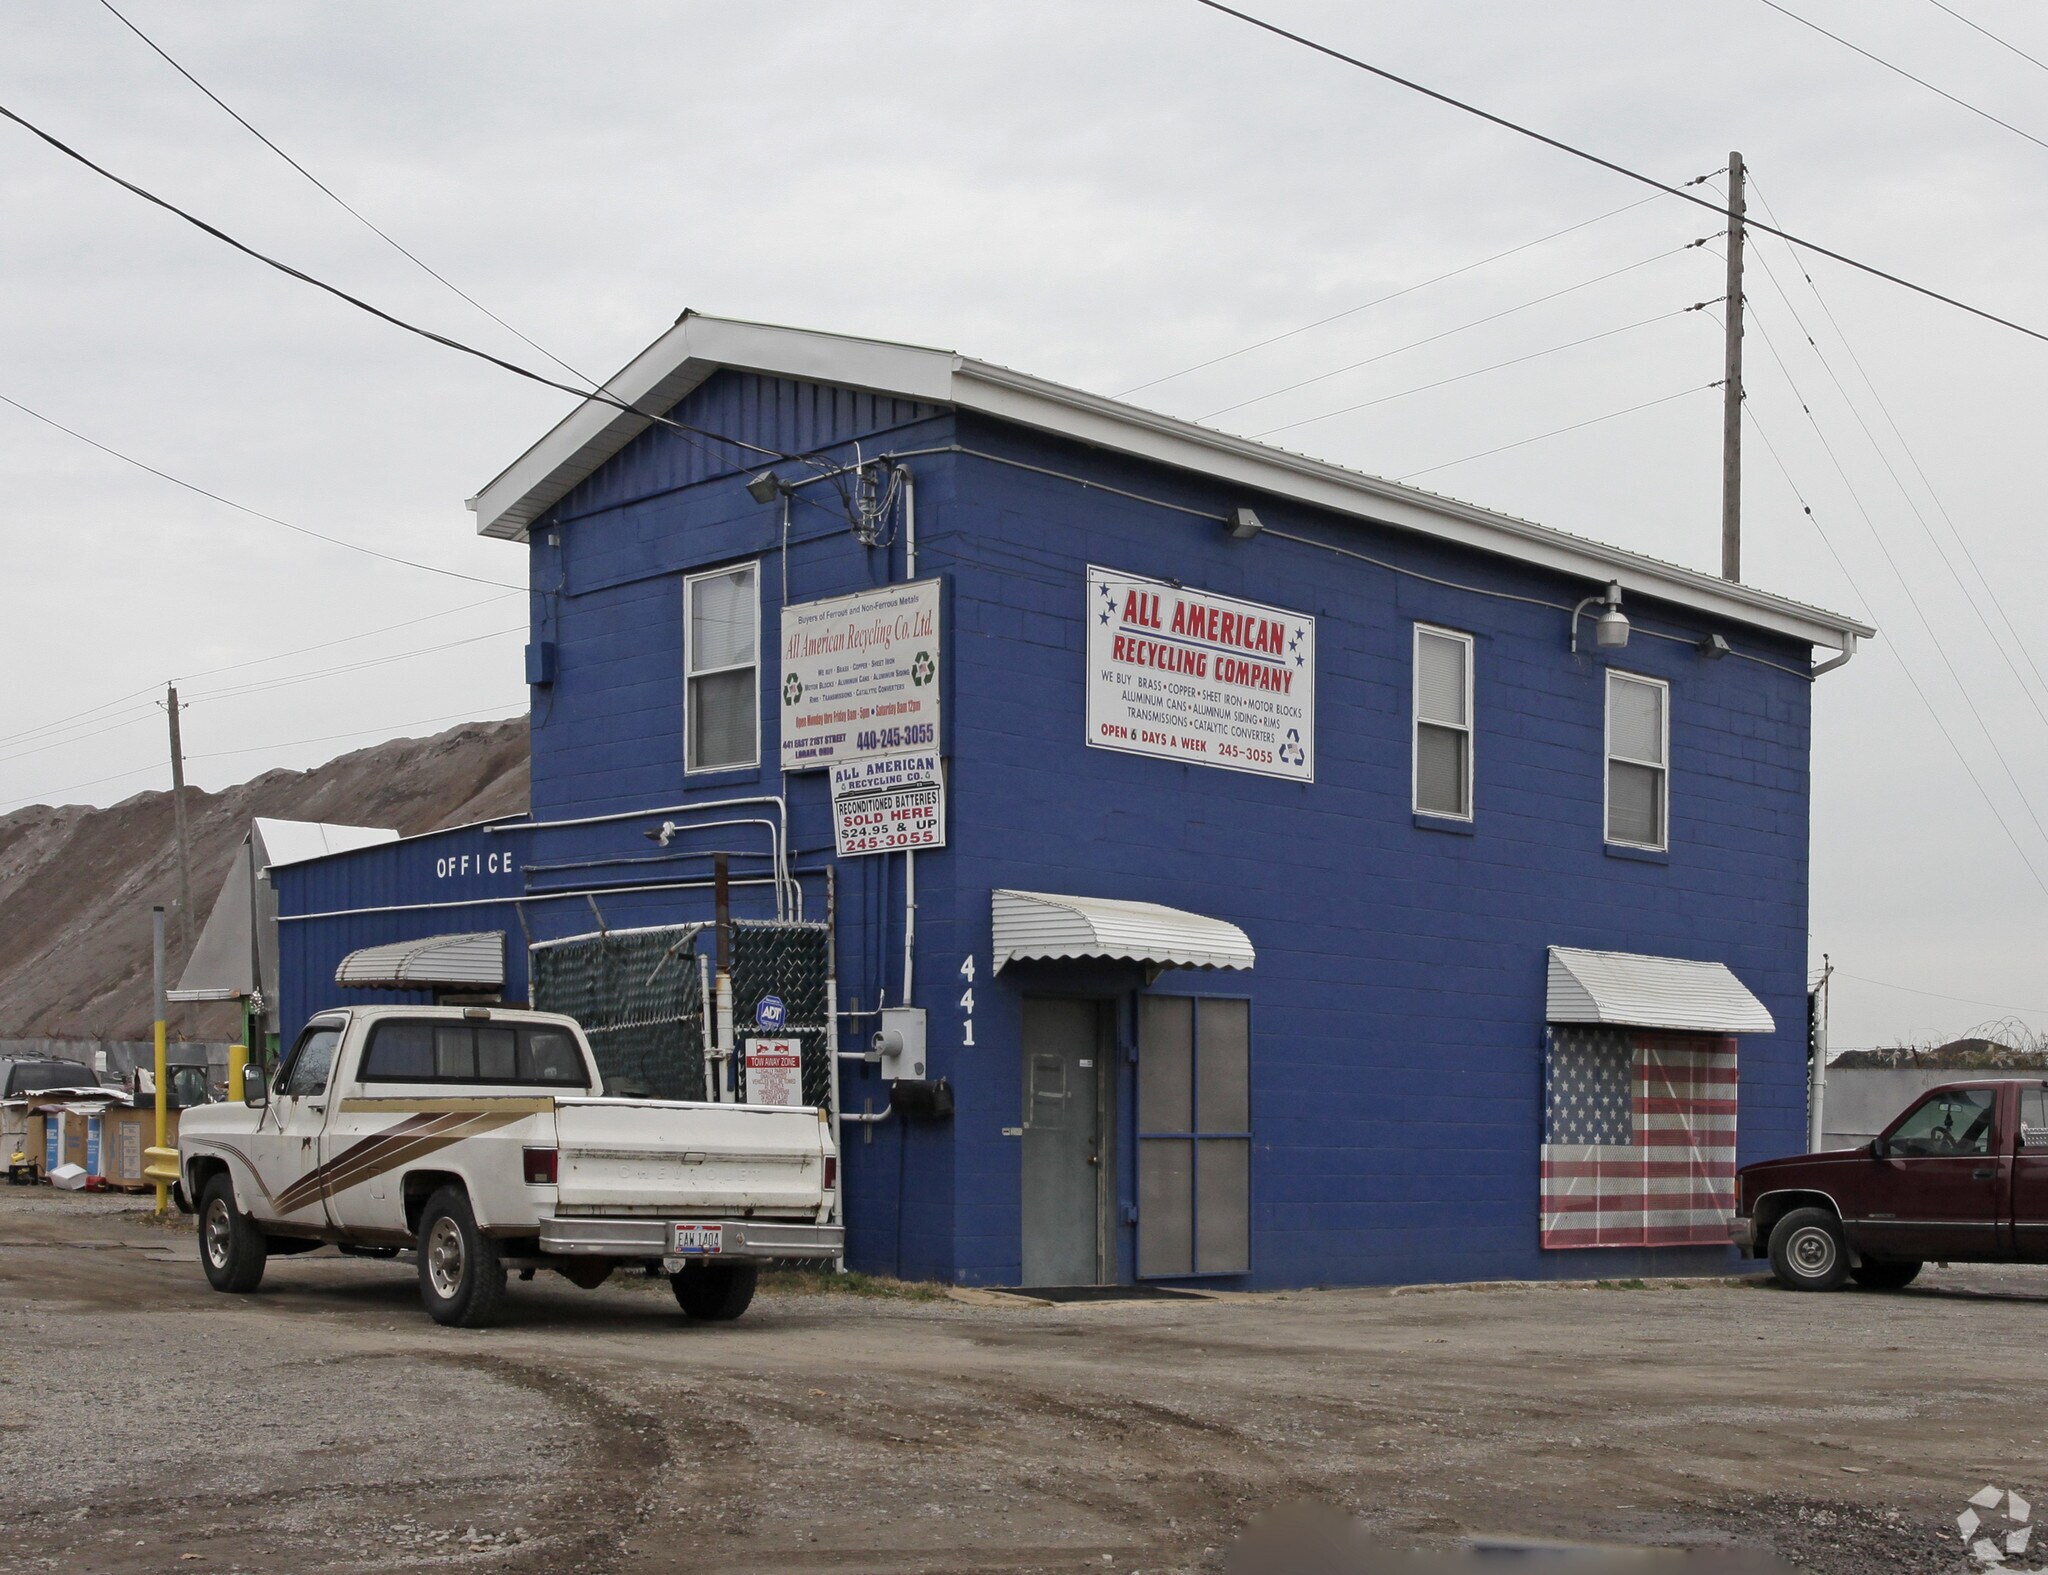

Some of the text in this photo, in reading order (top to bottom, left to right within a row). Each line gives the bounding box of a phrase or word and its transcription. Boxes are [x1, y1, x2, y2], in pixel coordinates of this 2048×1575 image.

[798, 615, 818, 625] Buyers
[826, 608, 848, 619] Ferrous
[849, 604, 860, 615] and
[861, 600, 898, 612] Non-Ferrous
[899, 594, 919, 604] Metals
[785, 609, 933, 659] All American Recycling Co. Ltd.
[1122, 590, 1285, 656] ALL AMERICAN
[1112, 634, 1294, 694] RECYCLING COMPANY
[1101, 670, 1302, 718] WE BUY BRASS COPPER SHEET IRON MOTOR BLOCKS
[795, 716, 806, 729] Open
[807, 714, 824, 726] Monday
[824, 712, 833, 724] thru
[833, 710, 847, 723] Friday
[860, 707, 870, 720] 5pm
[876, 704, 897, 717] Saturday
[1122, 690, 1281, 729] ALUMINUM CANS ALUMINUM SIDING RIMS
[856, 723, 934, 751] 440-245-3055
[1128, 707, 1275, 744] TRANSMISSIONS CATALYTIC CONVERTERS
[782, 733, 847, 750] 441 EAST 21ST STREET
[818, 747, 834, 757] OHIO
[1101, 723, 1273, 764] OPEN 6 DAYS A WEEK 245-3055
[836, 757, 934, 783] ALL AMERICAN
[848, 772, 923, 789] RECYCLING CO.
[839, 791, 937, 815] RECONDITIONED BATTERIES
[841, 819, 937, 839] $24.95 & UP
[843, 806, 933, 827] SOLD HERE
[846, 831, 934, 851] 245-3055
[437, 852, 512, 878] OFFICE
[761, 1006, 782, 1021] ADT
[751, 1057, 796, 1067] TOW AWAY ZONE
